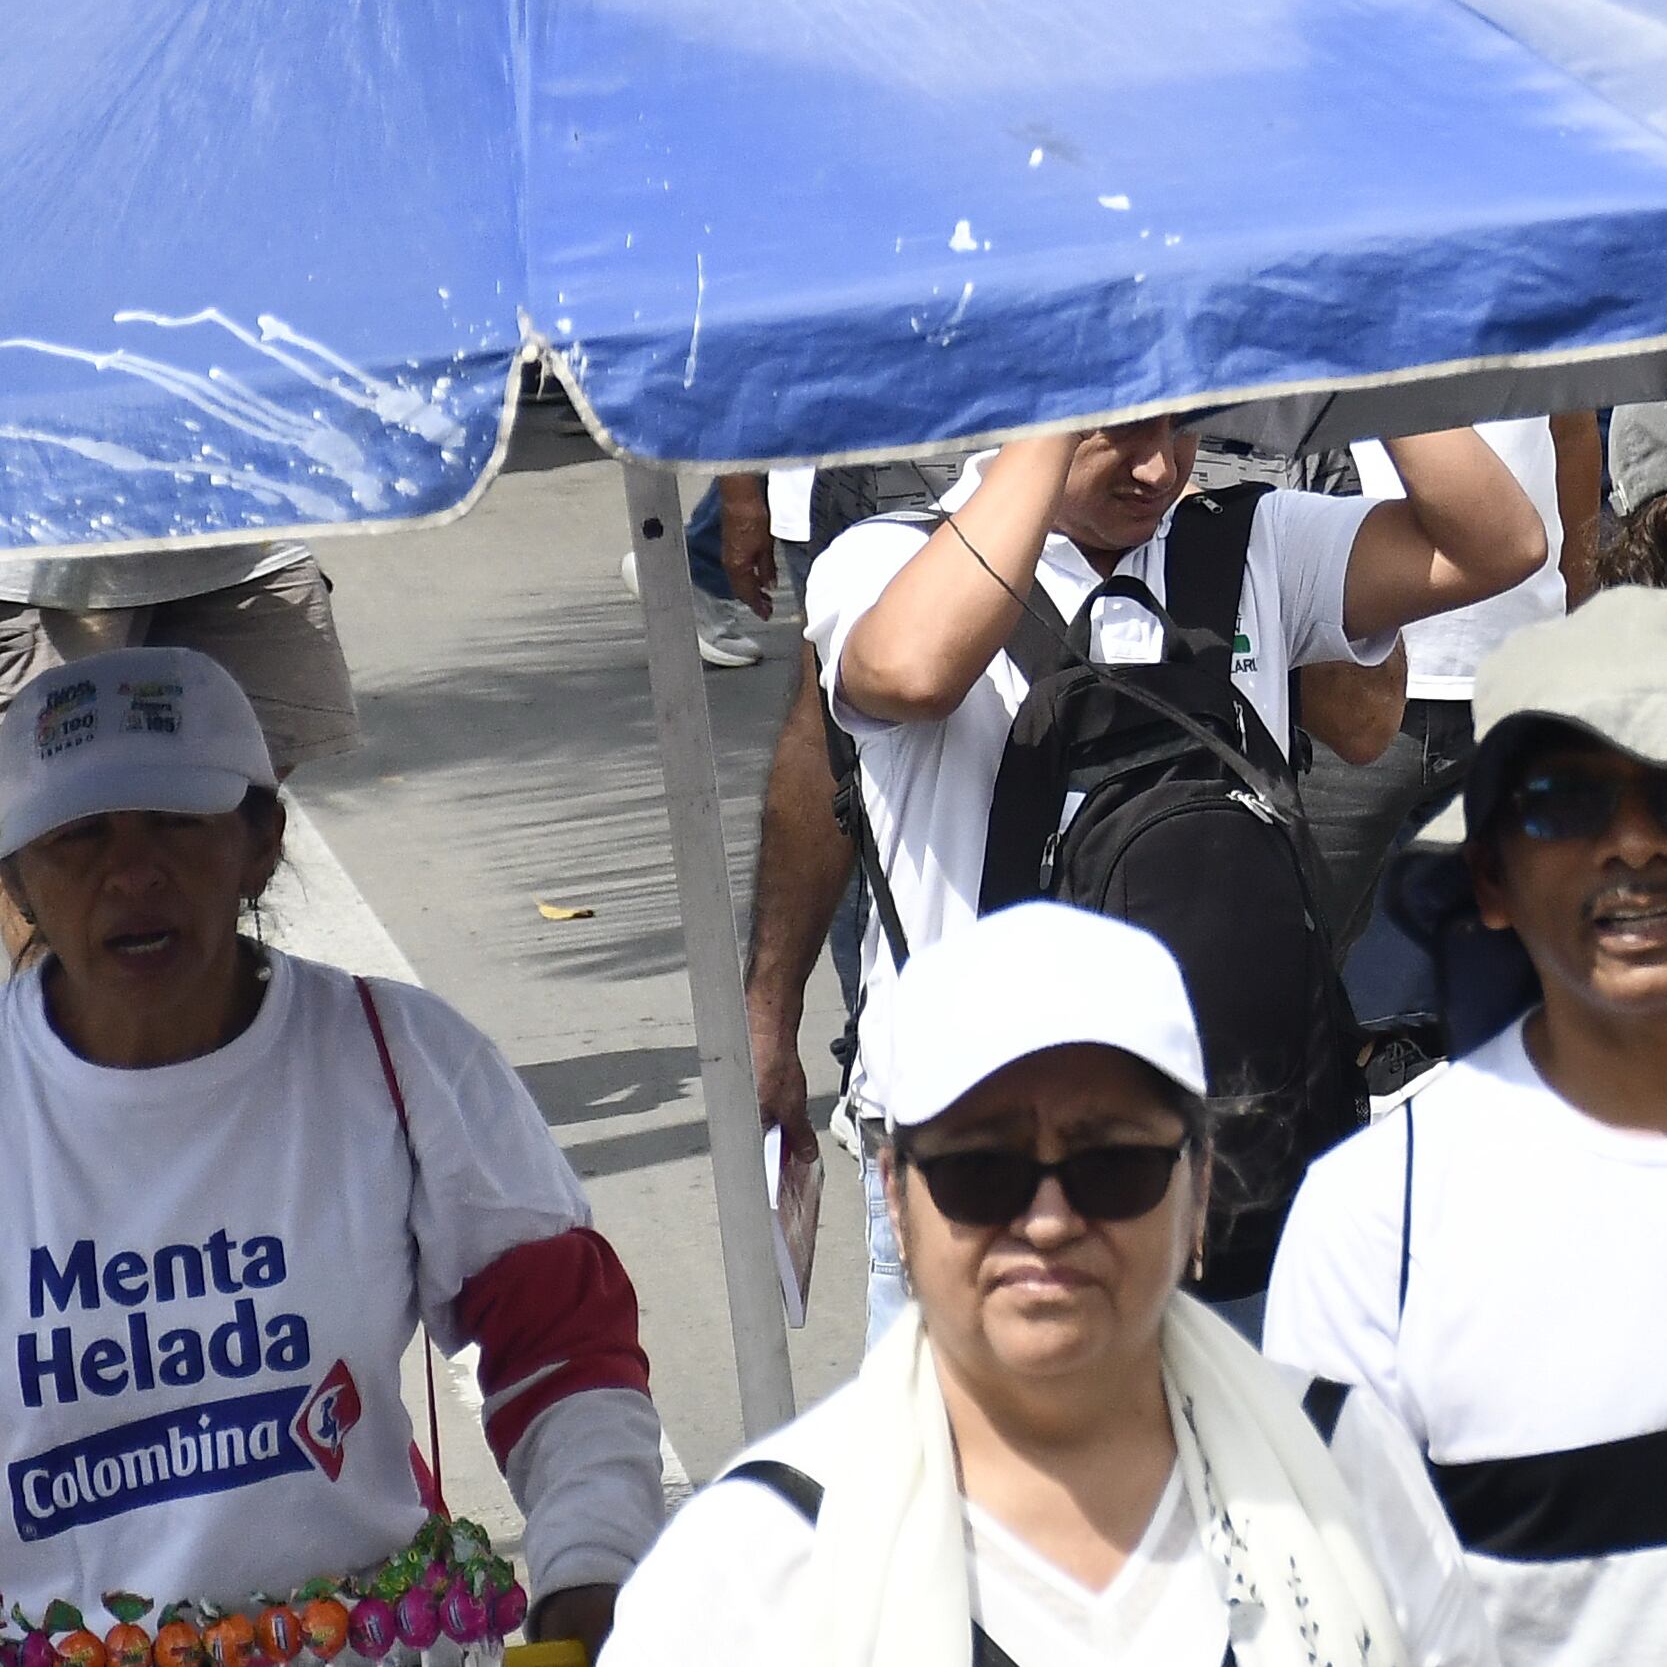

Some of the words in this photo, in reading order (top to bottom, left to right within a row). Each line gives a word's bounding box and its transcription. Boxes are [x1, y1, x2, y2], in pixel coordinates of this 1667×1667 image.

[30, 1228, 288, 1318] Menta
[17, 1298, 311, 1407] Helada
[22, 1413, 280, 1519] Colombina
